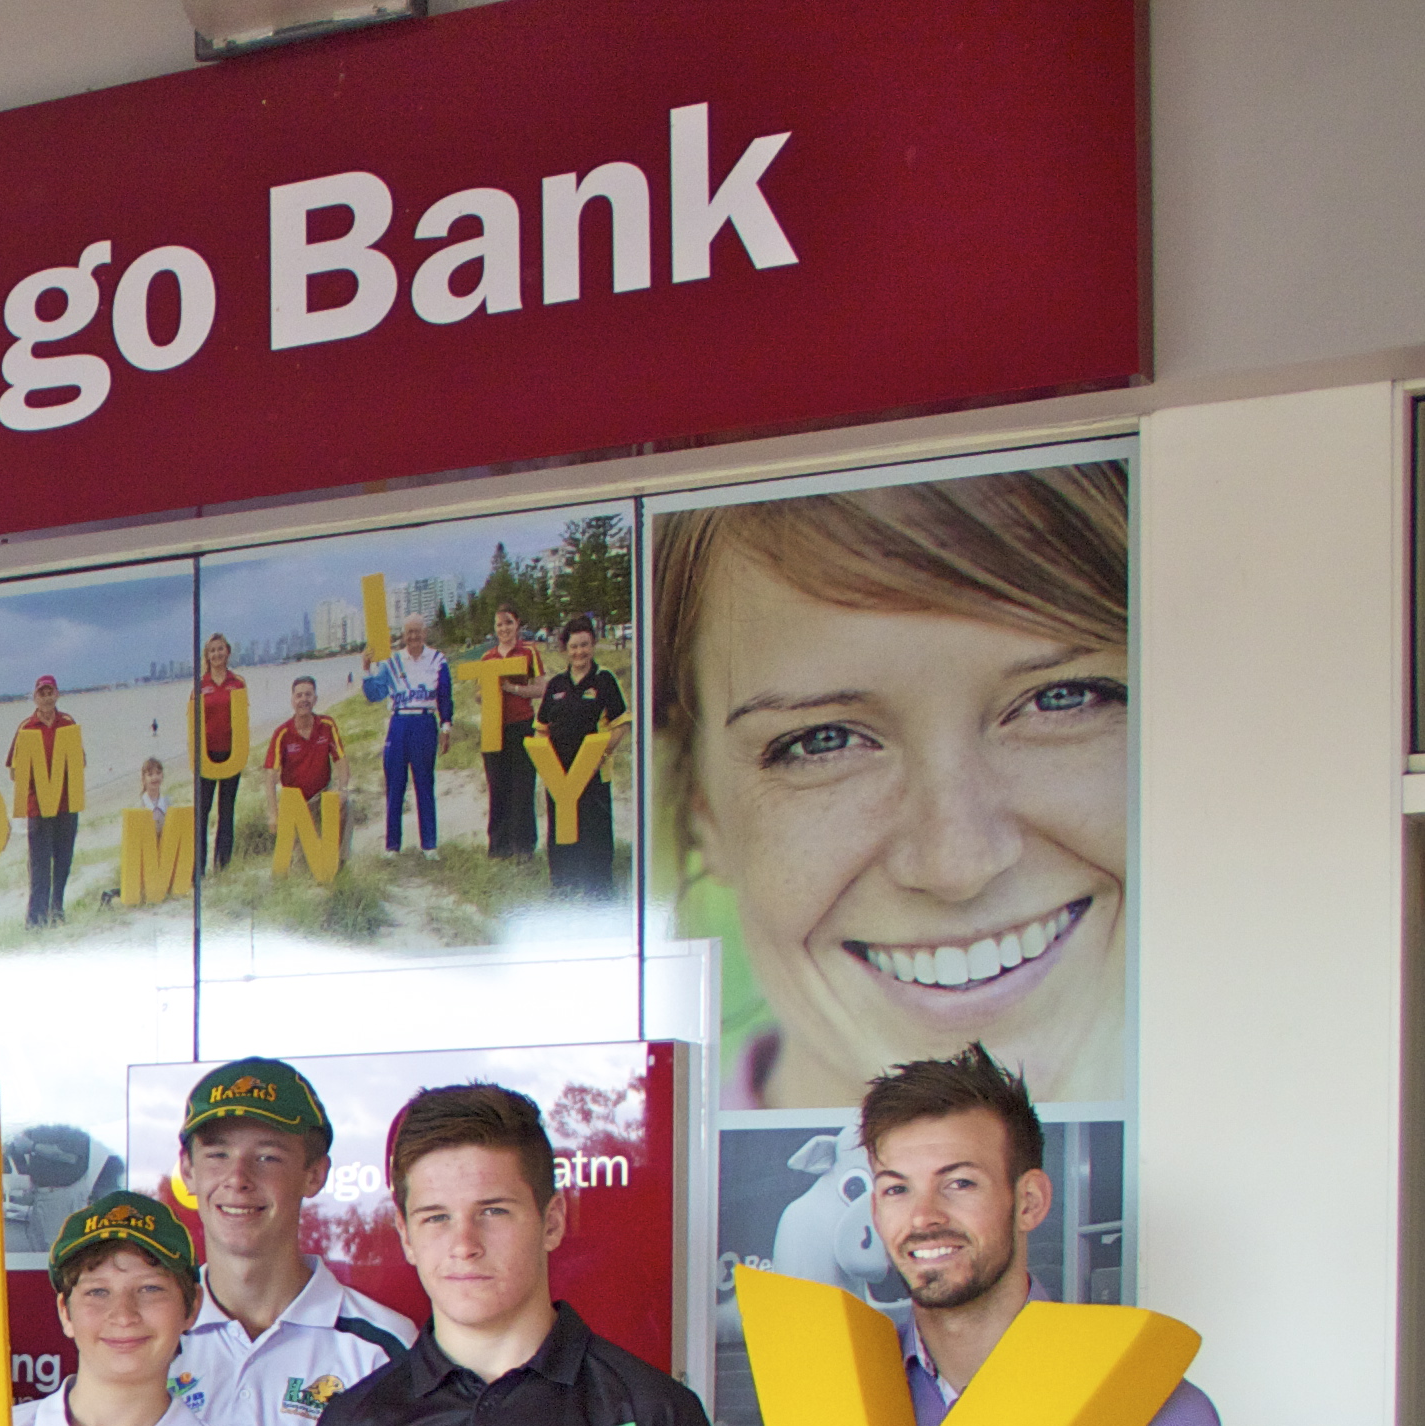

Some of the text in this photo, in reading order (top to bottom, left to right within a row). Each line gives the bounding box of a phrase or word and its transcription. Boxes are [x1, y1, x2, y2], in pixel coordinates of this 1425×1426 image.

[268, 102, 800, 353] Bank
[210, 1083, 277, 1103] HAKS
[552, 1150, 628, 1188] atm
[85, 1215, 156, 1234] HAKS
